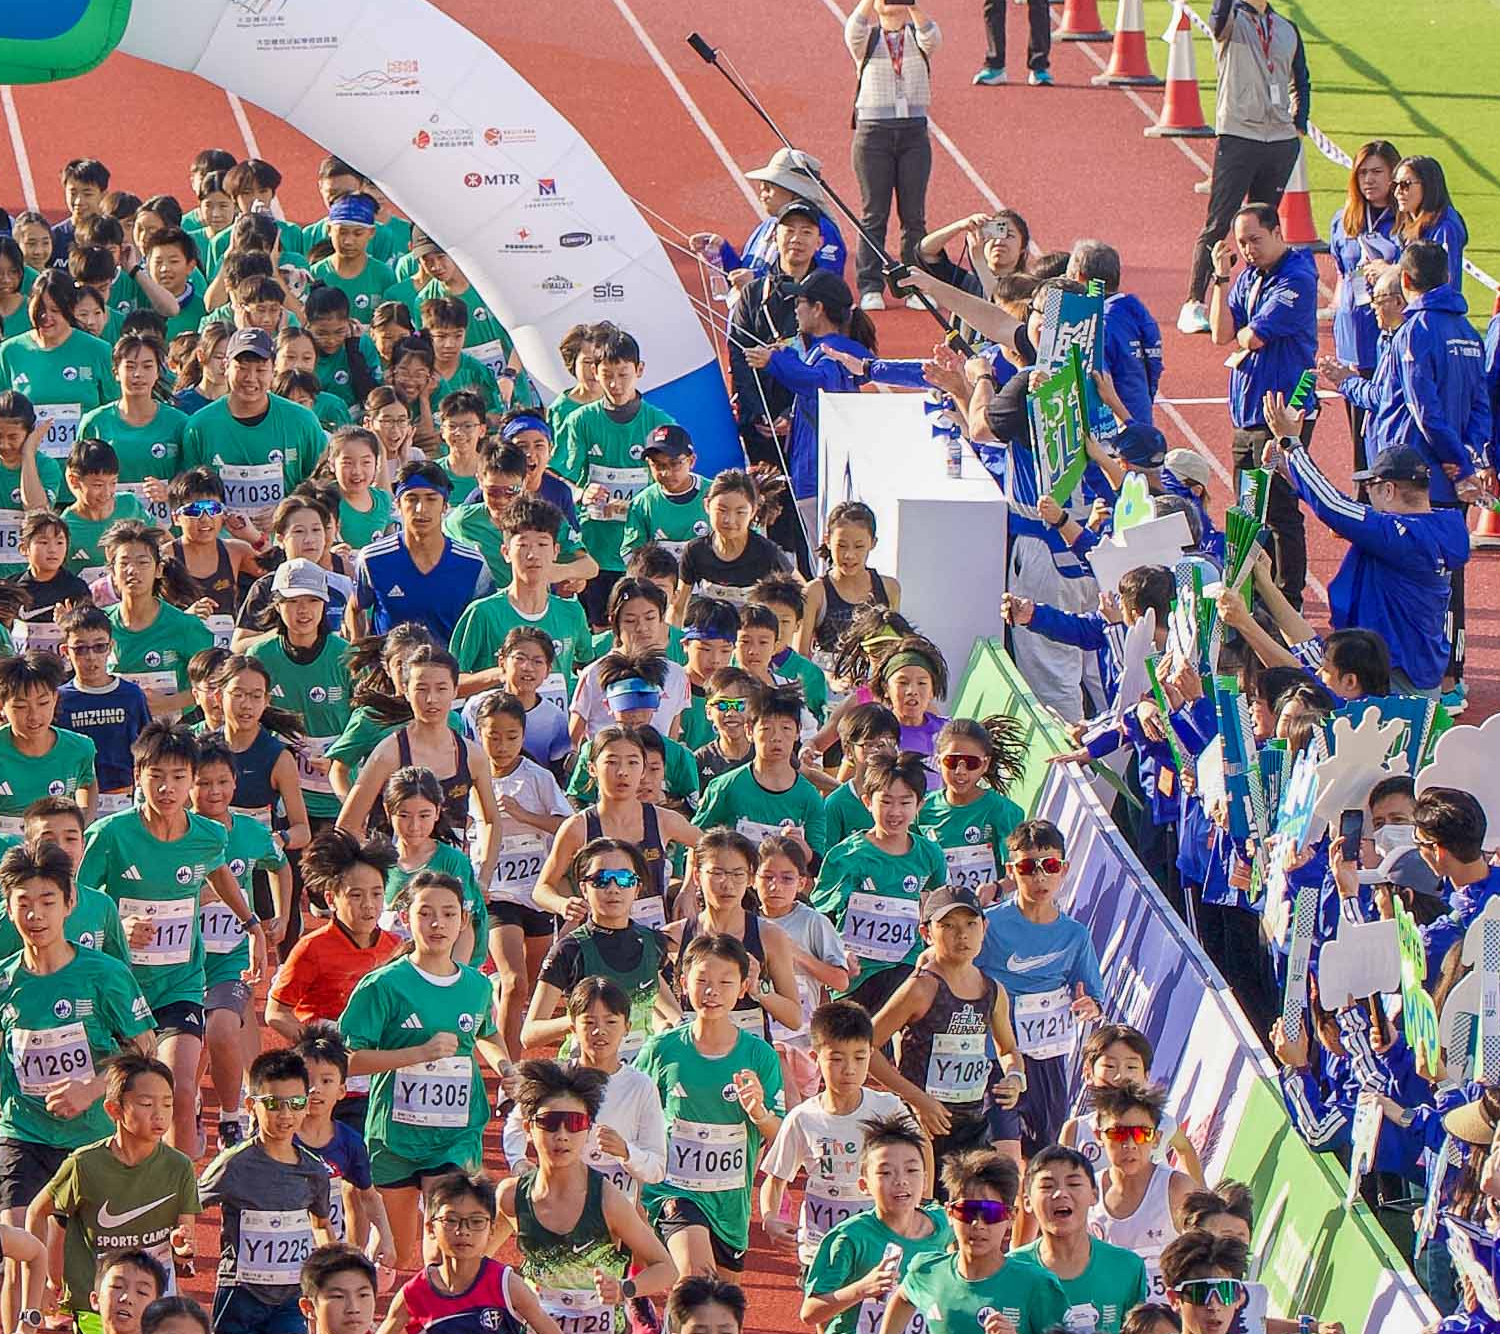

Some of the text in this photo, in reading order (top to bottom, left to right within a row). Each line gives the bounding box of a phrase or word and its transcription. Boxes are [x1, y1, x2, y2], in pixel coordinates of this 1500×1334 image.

[484, 173, 521, 186] MTR
[225, 484, 282, 503] Y1038
[70, 706, 126, 728] MIZUNO
[851, 917, 914, 947] Y1294
[17, 1047, 89, 1078] Y1269
[400, 1079, 469, 1108] Y1305
[674, 1147, 745, 1172] Y1066
[97, 1233, 141, 1249] SPORTS
[244, 1238, 311, 1265] Y1225
